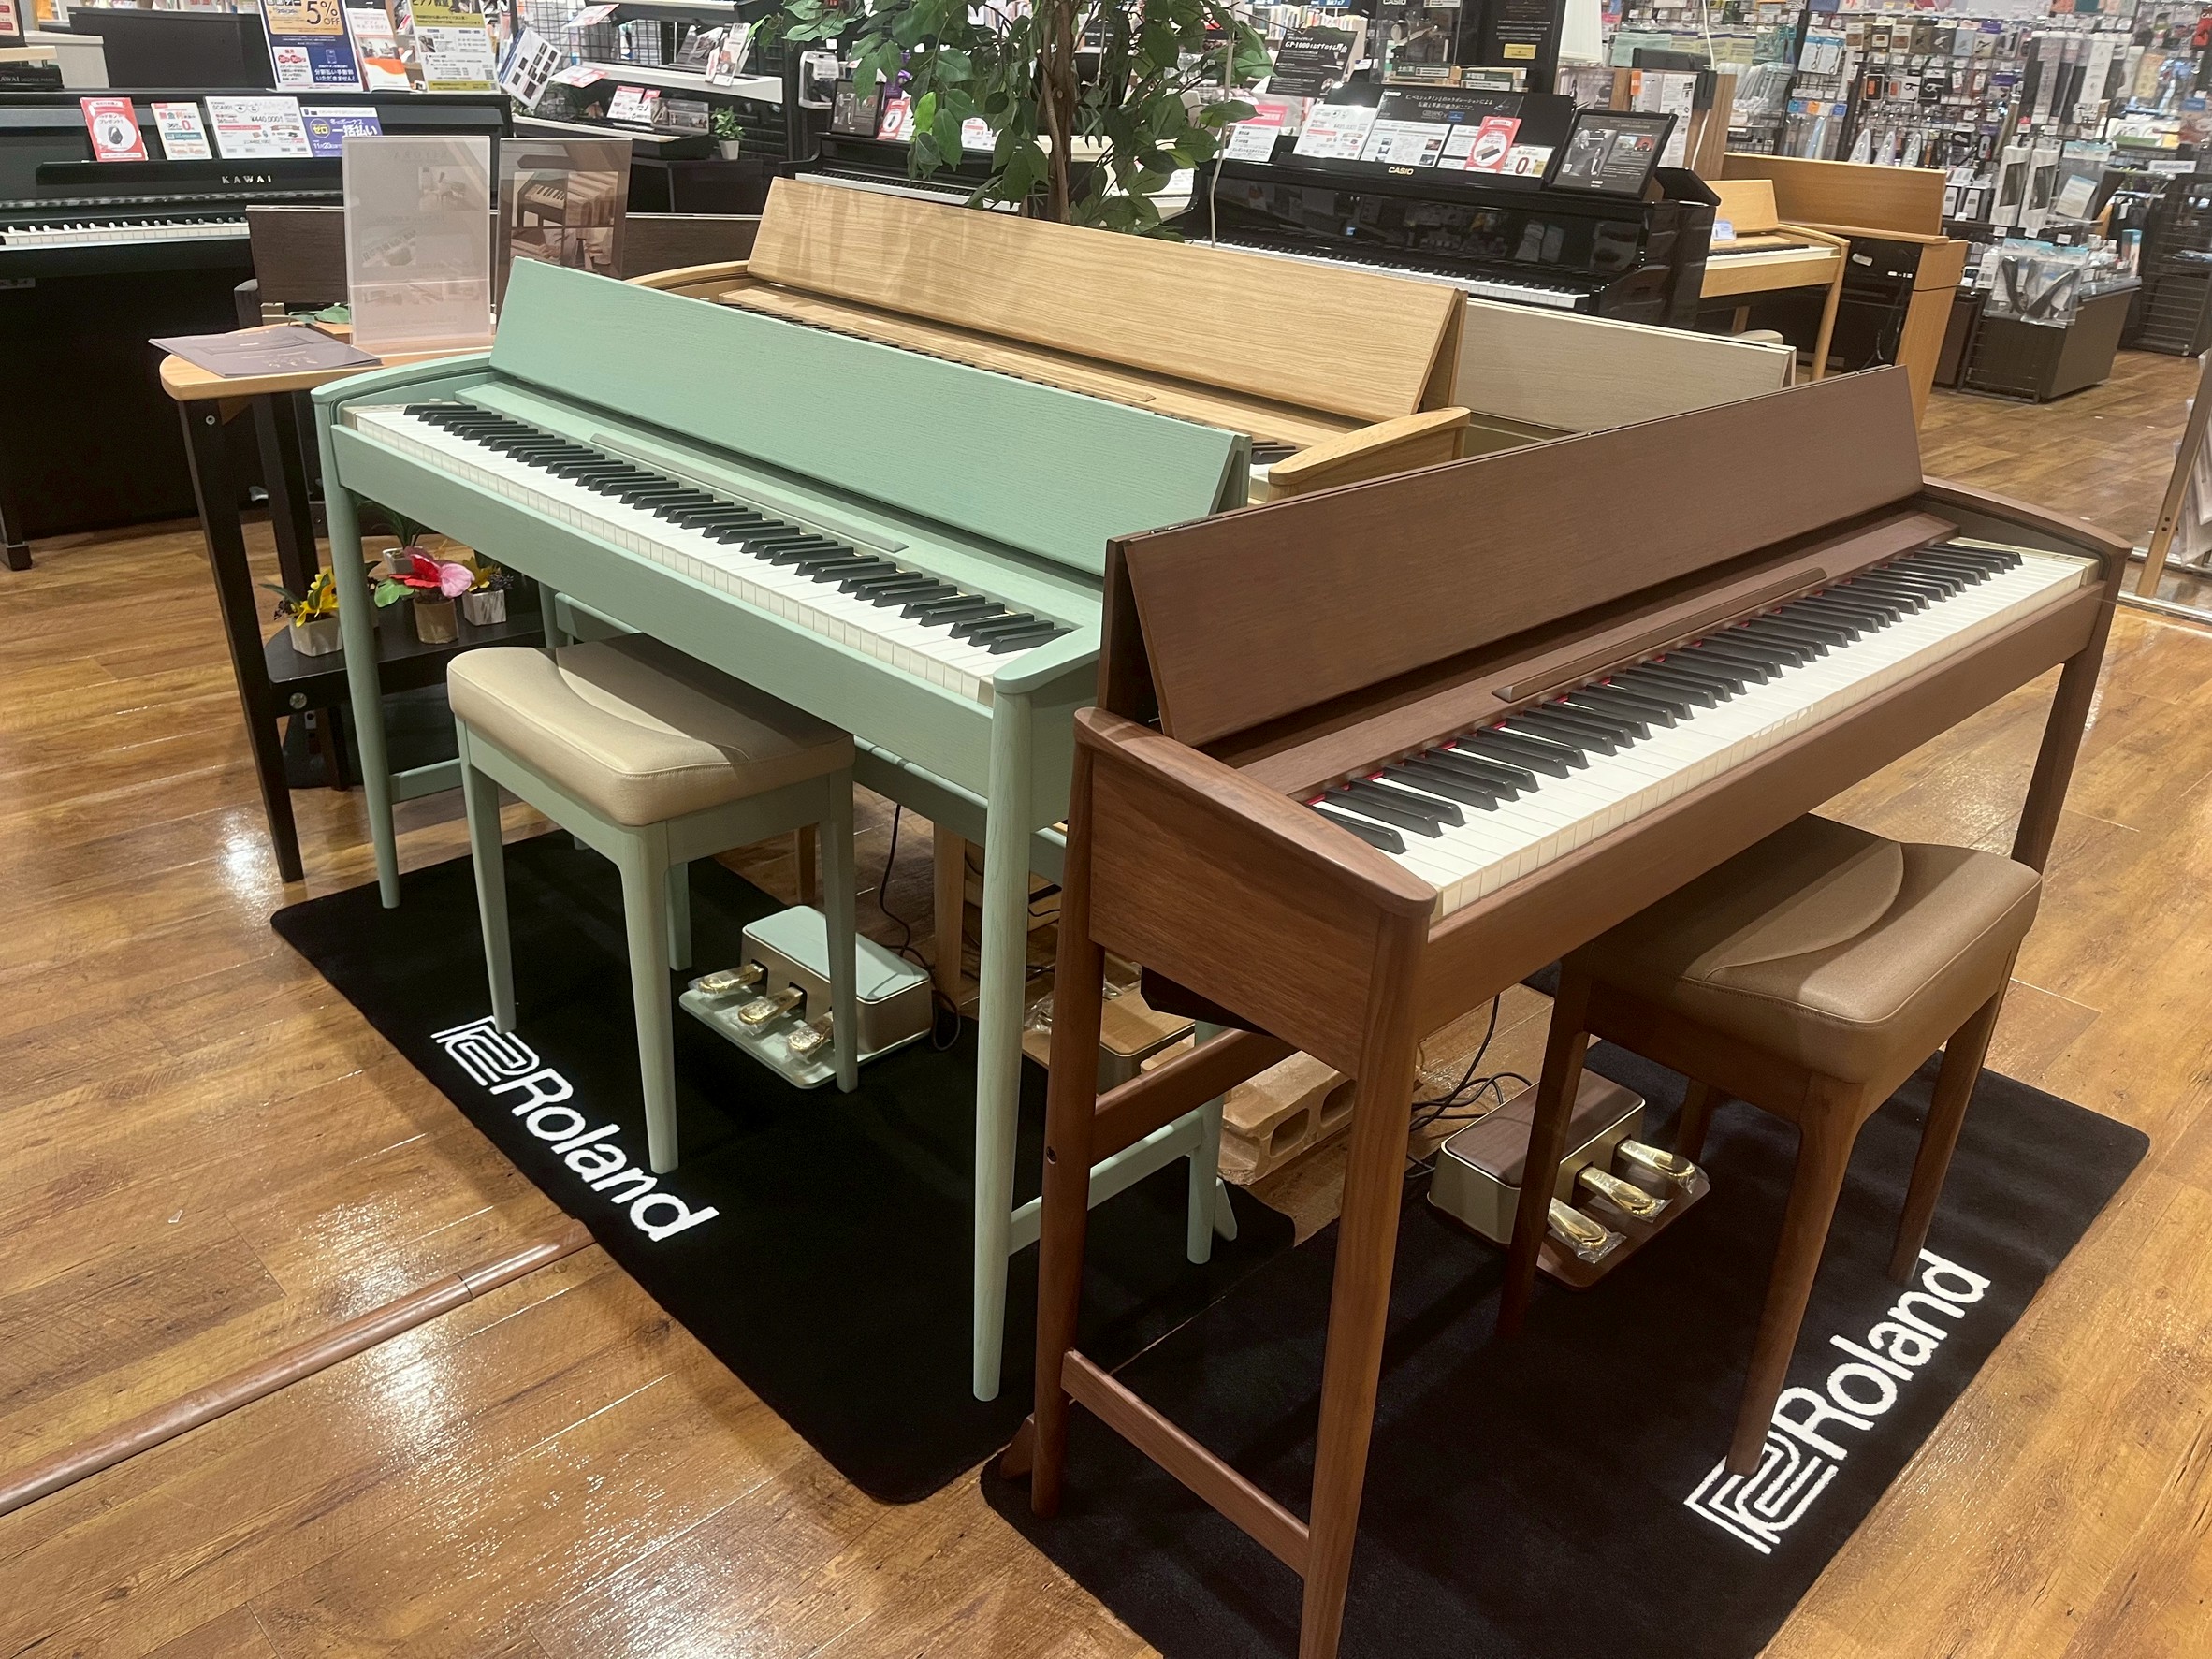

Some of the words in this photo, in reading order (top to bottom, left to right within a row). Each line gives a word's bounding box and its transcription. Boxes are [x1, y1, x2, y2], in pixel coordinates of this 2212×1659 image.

[324, 17, 340, 25] OFF
[313, 126, 328, 135] ゼロ
[1388, 166, 1415, 176] CASIO
[221, 174, 272, 184] KAWAI
[489, 1068, 720, 1243] Roland
[1770, 1247, 1992, 1462] Roland
